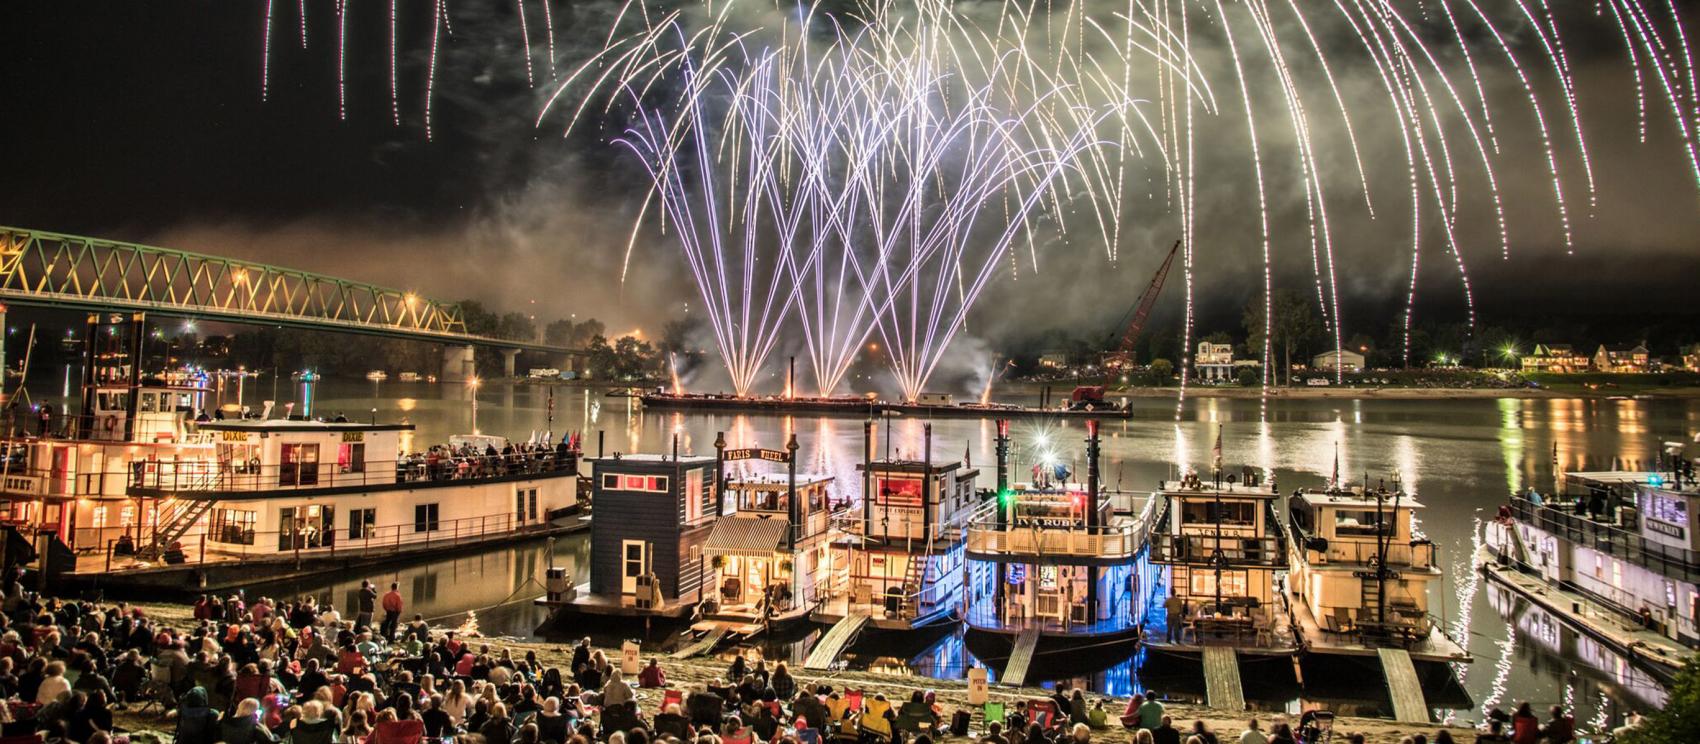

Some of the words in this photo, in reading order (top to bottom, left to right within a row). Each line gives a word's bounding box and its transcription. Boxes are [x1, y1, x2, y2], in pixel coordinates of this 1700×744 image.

[223, 431, 247, 441] DIXIE
[343, 432, 363, 442] DIXIE
[760, 450, 783, 462] WHEEL
[1043, 519, 1080, 527] RUBY
